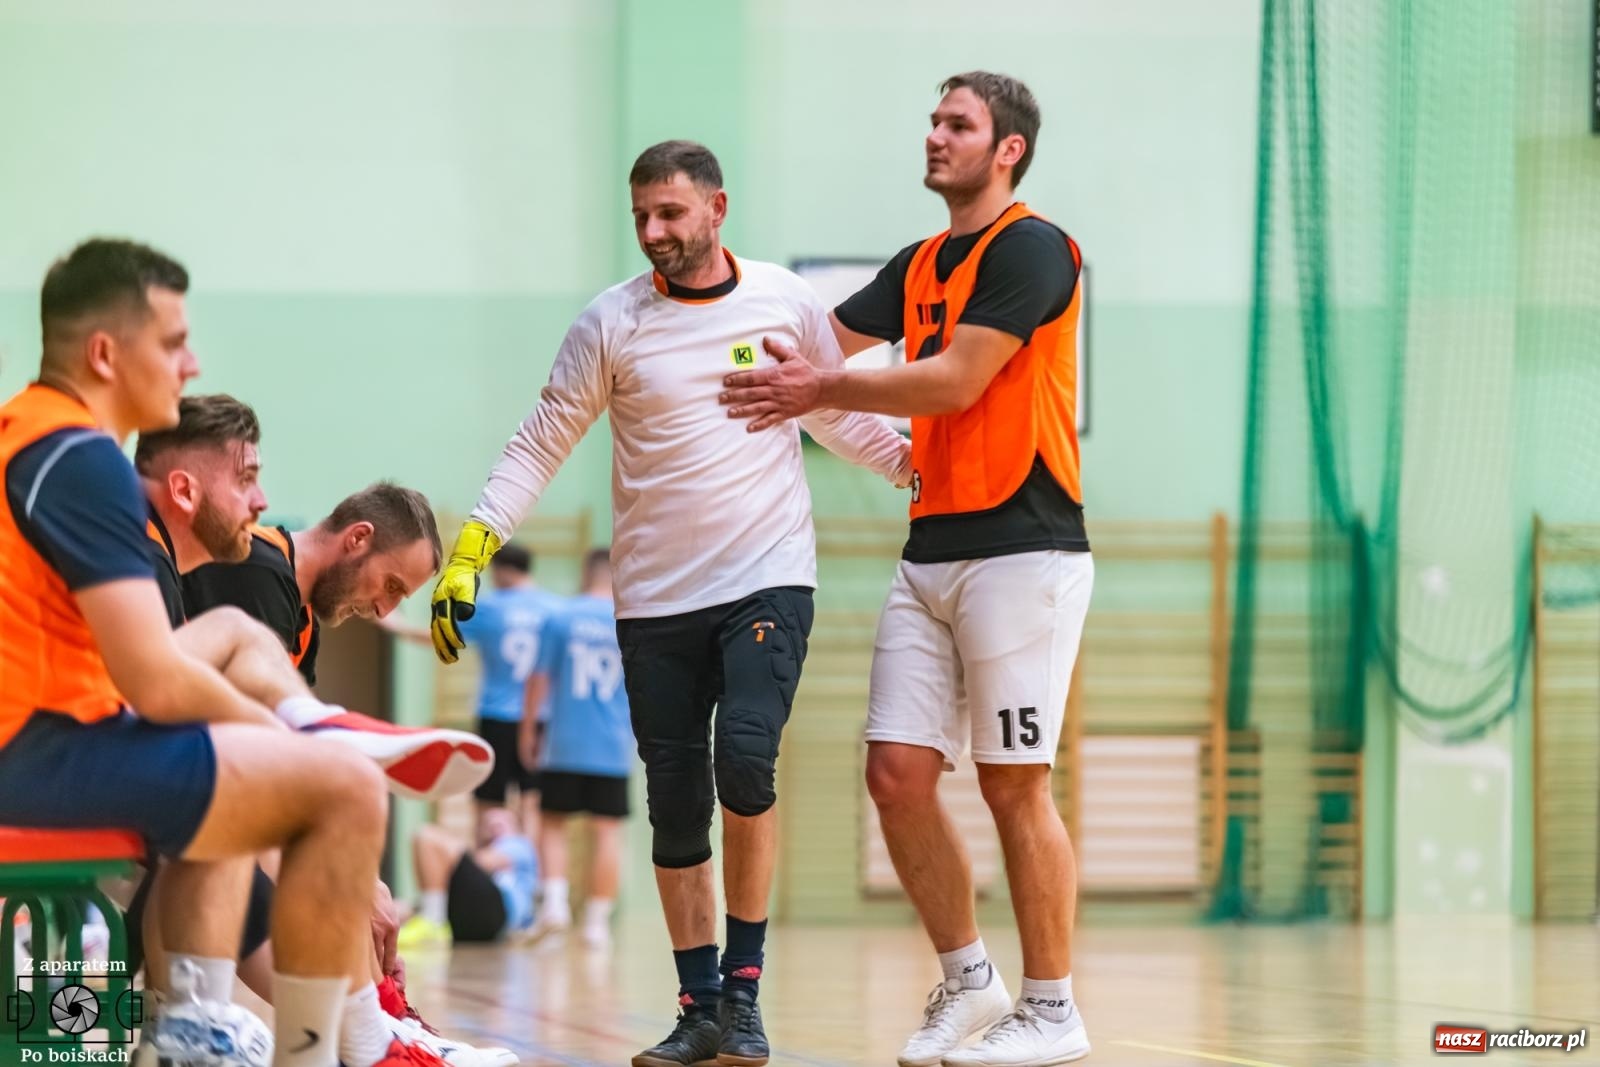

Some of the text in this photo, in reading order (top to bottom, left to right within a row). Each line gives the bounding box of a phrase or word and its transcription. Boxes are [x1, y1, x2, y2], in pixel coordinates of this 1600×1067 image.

[501, 630, 539, 683] 9
[569, 643, 622, 702] 19
[998, 707, 1041, 750] 15
